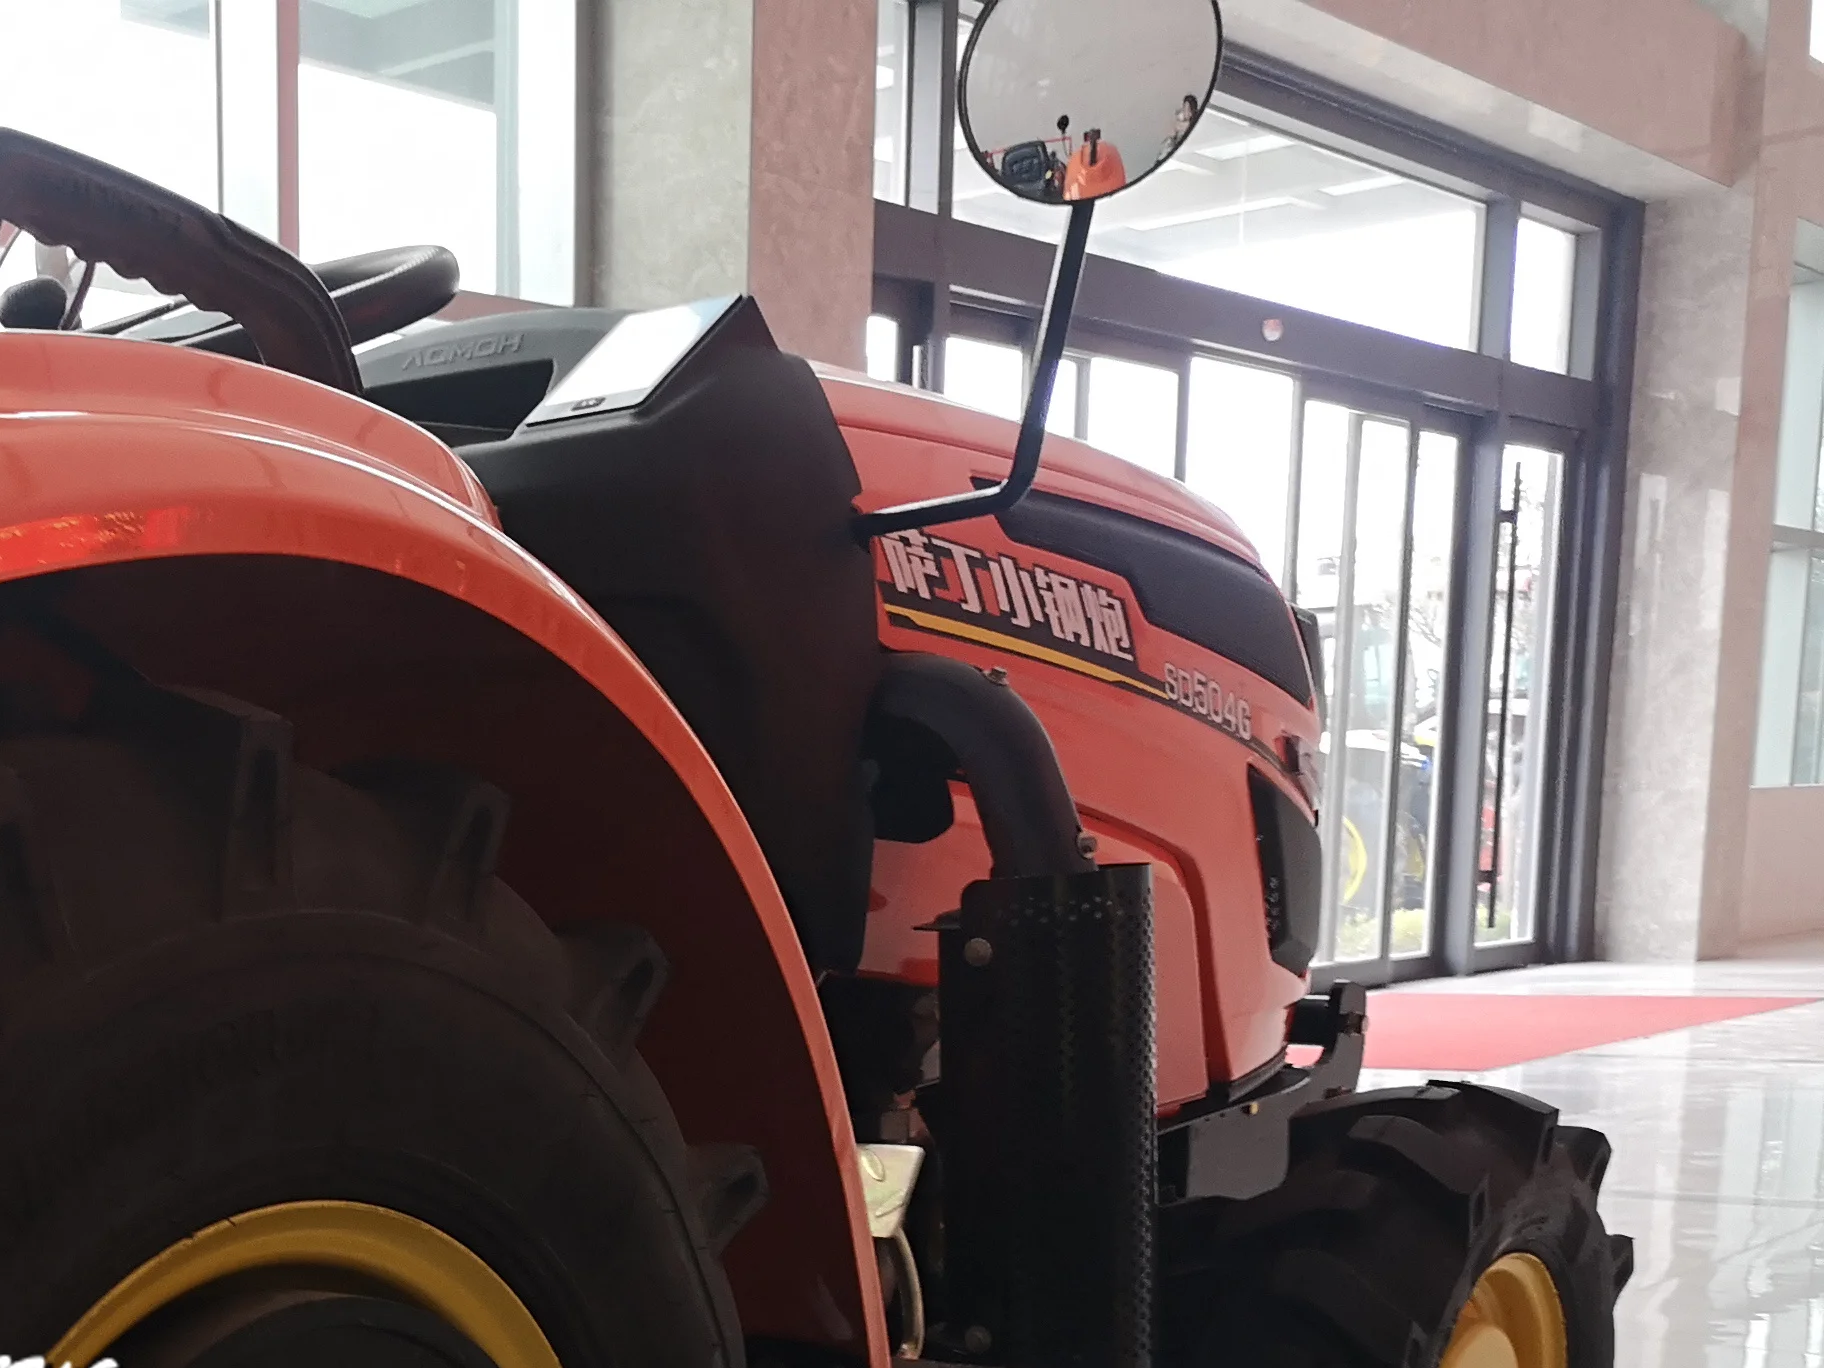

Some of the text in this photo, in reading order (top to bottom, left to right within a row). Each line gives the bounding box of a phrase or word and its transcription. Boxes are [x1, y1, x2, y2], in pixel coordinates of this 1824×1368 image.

[880, 529, 1134, 661] 萨丁小钢炮
[1163, 661, 1254, 741] SD504G
